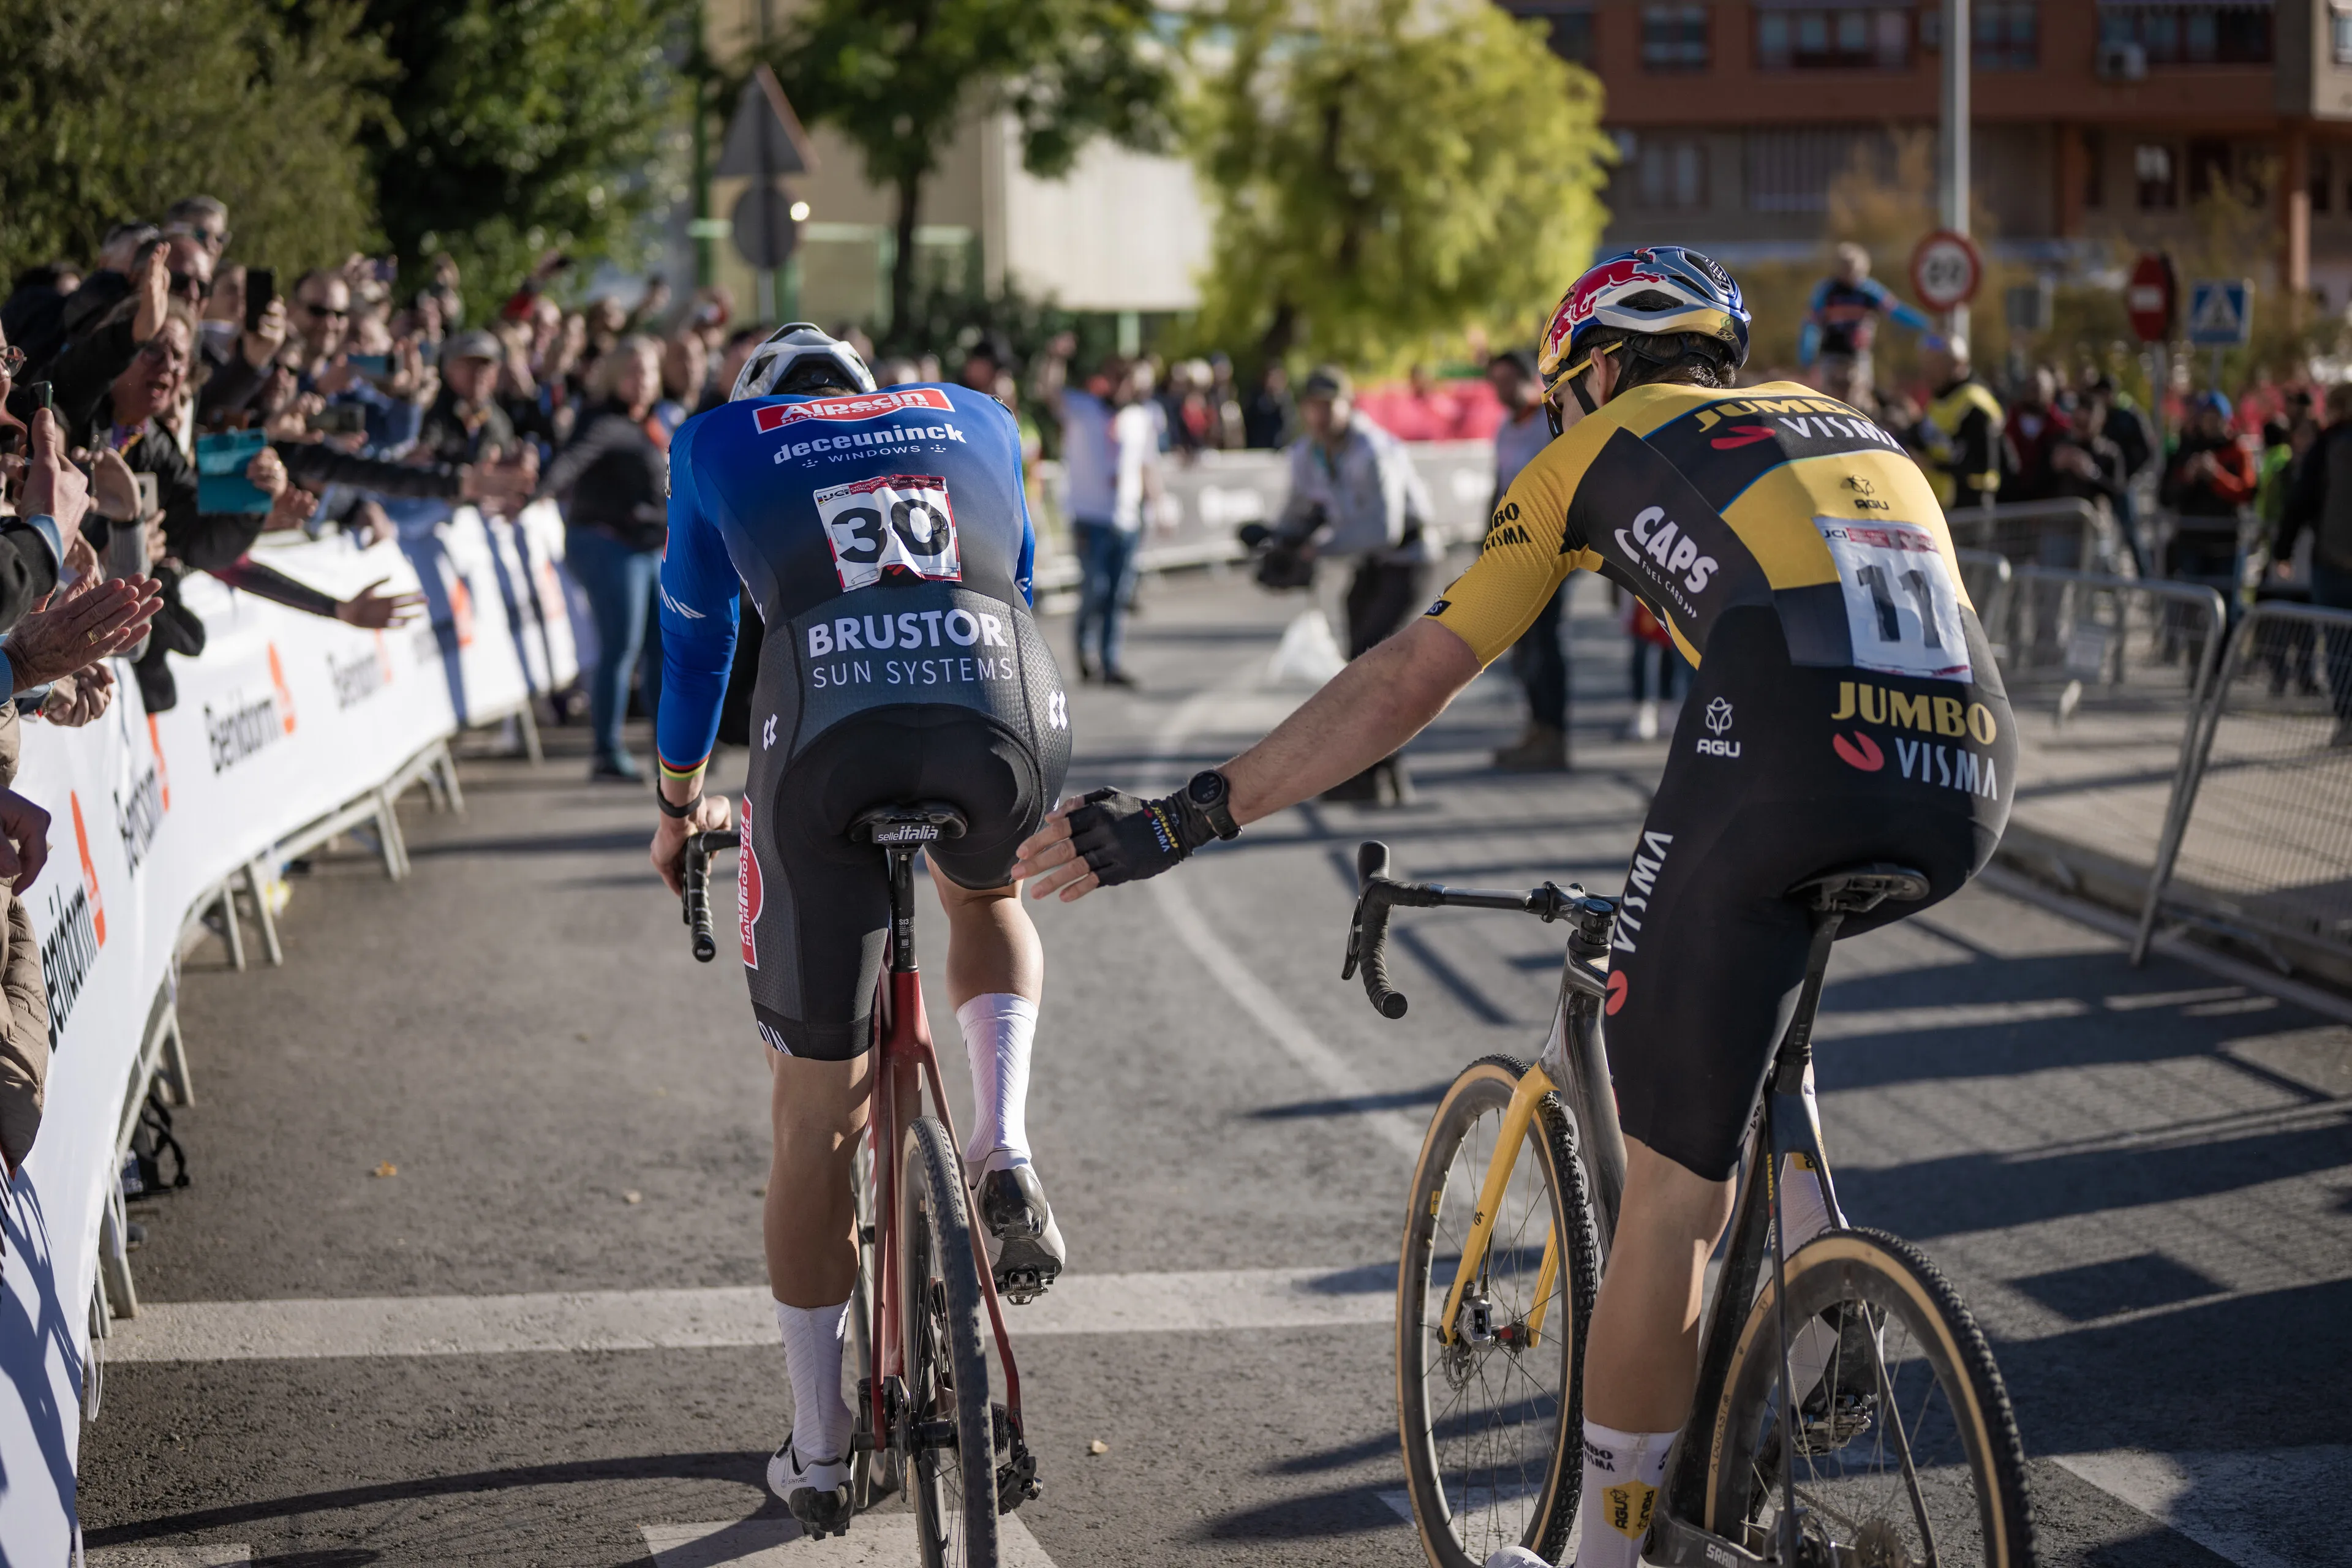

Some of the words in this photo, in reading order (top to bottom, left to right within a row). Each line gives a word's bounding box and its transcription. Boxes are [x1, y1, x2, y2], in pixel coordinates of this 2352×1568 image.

[780, 393, 927, 420] Alpecin
[782, 412, 826, 424] HAIR
[838, 401, 930, 415] BOOSTER
[774, 423, 967, 464] deceuninck
[828, 445, 921, 462] WINDOWS
[1854, 499, 1890, 510] AGU
[831, 499, 950, 564] 30
[1632, 506, 1719, 594] CAPS
[1642, 560, 1661, 584] FUEL
[1665, 581, 1683, 605] CARD
[1856, 565, 1942, 649] 11
[809, 608, 1008, 658] BRUSTOR
[813, 660, 871, 688] SUN
[886, 658, 1013, 685] SYSTEMS
[1831, 681, 1997, 745] JUMBO
[1696, 738, 1741, 758] AGU
[1894, 737, 1998, 801] VISMA
[1152, 818, 1170, 853] VISMA
[742, 818, 750, 897] BOOSTER
[1612, 831, 1674, 953] VISMA
[742, 907, 752, 946] HAIR
[1706, 1542, 1738, 1568] SRAM
